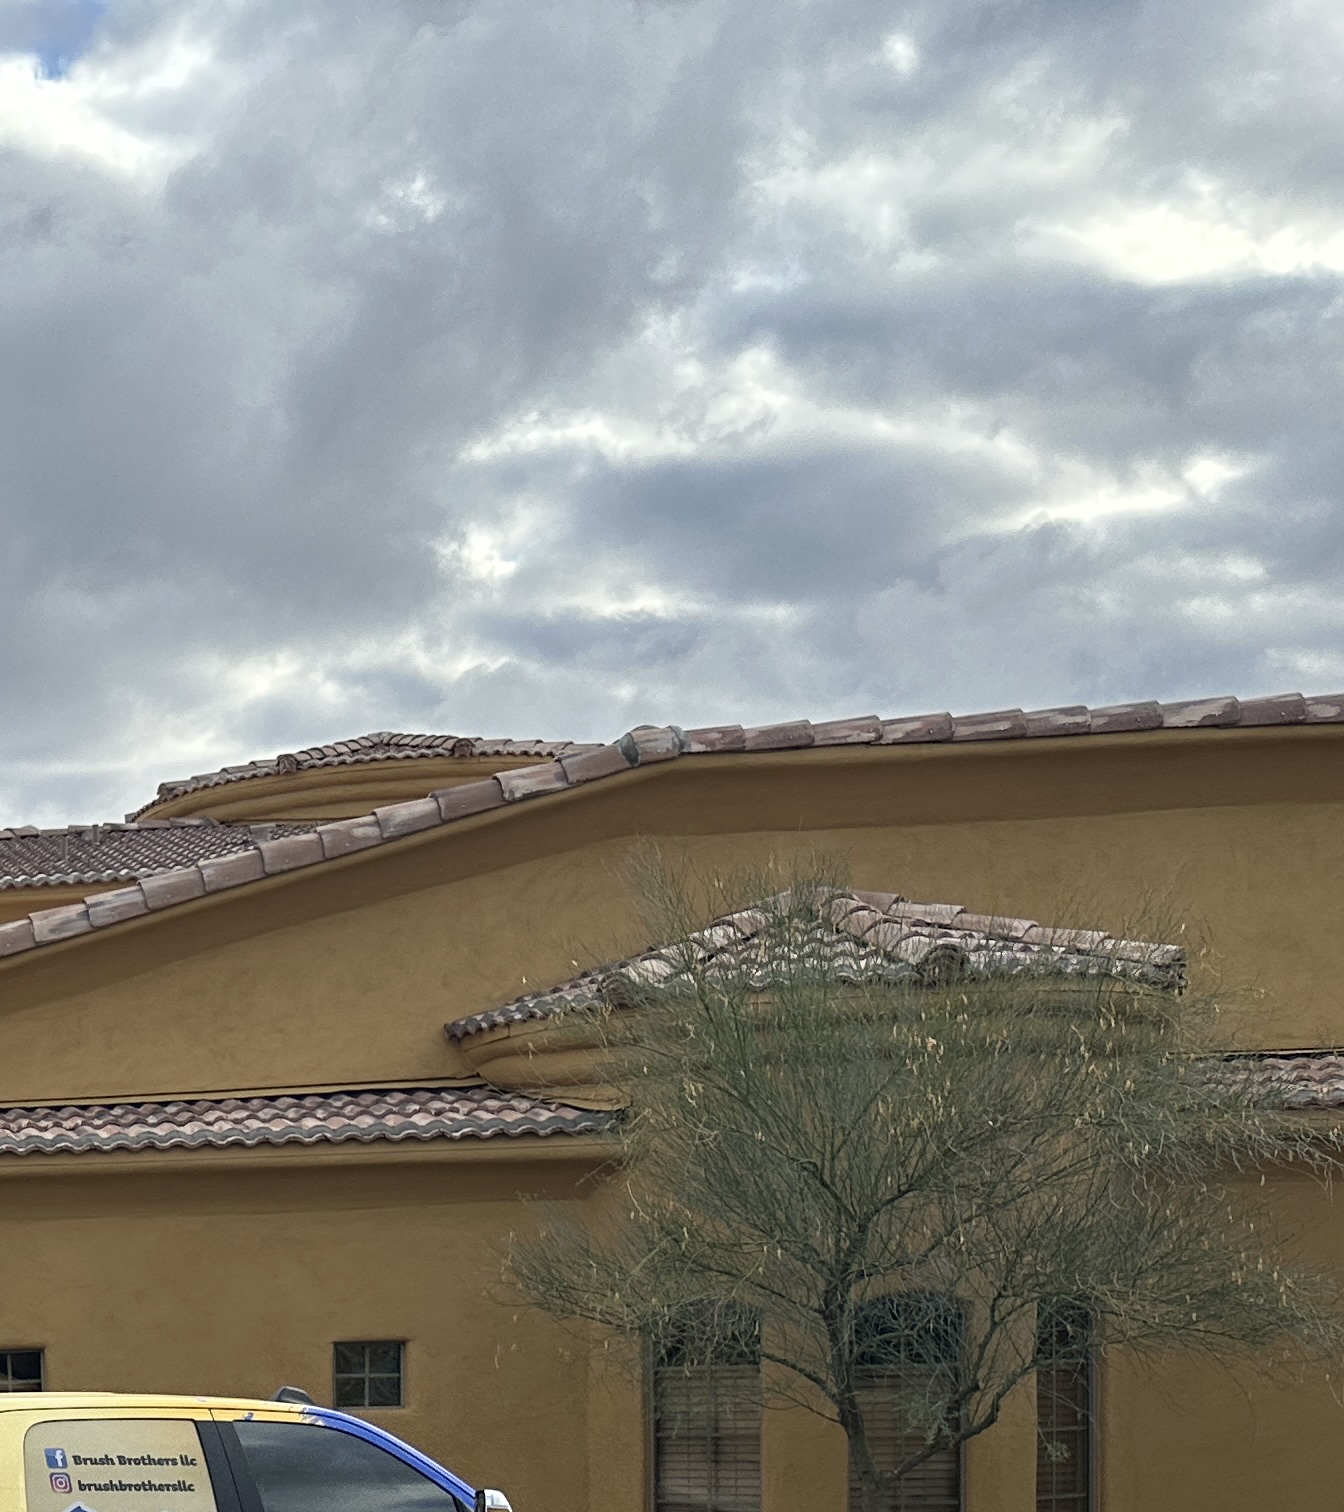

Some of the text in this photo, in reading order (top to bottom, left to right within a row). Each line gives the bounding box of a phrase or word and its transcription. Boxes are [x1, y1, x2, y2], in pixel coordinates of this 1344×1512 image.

[72, 1454, 115, 1466] Brush
[116, 1454, 178, 1467] Brothers
[180, 1454, 197, 1466] llc
[77, 1480, 196, 1492] brushbrothersllc
